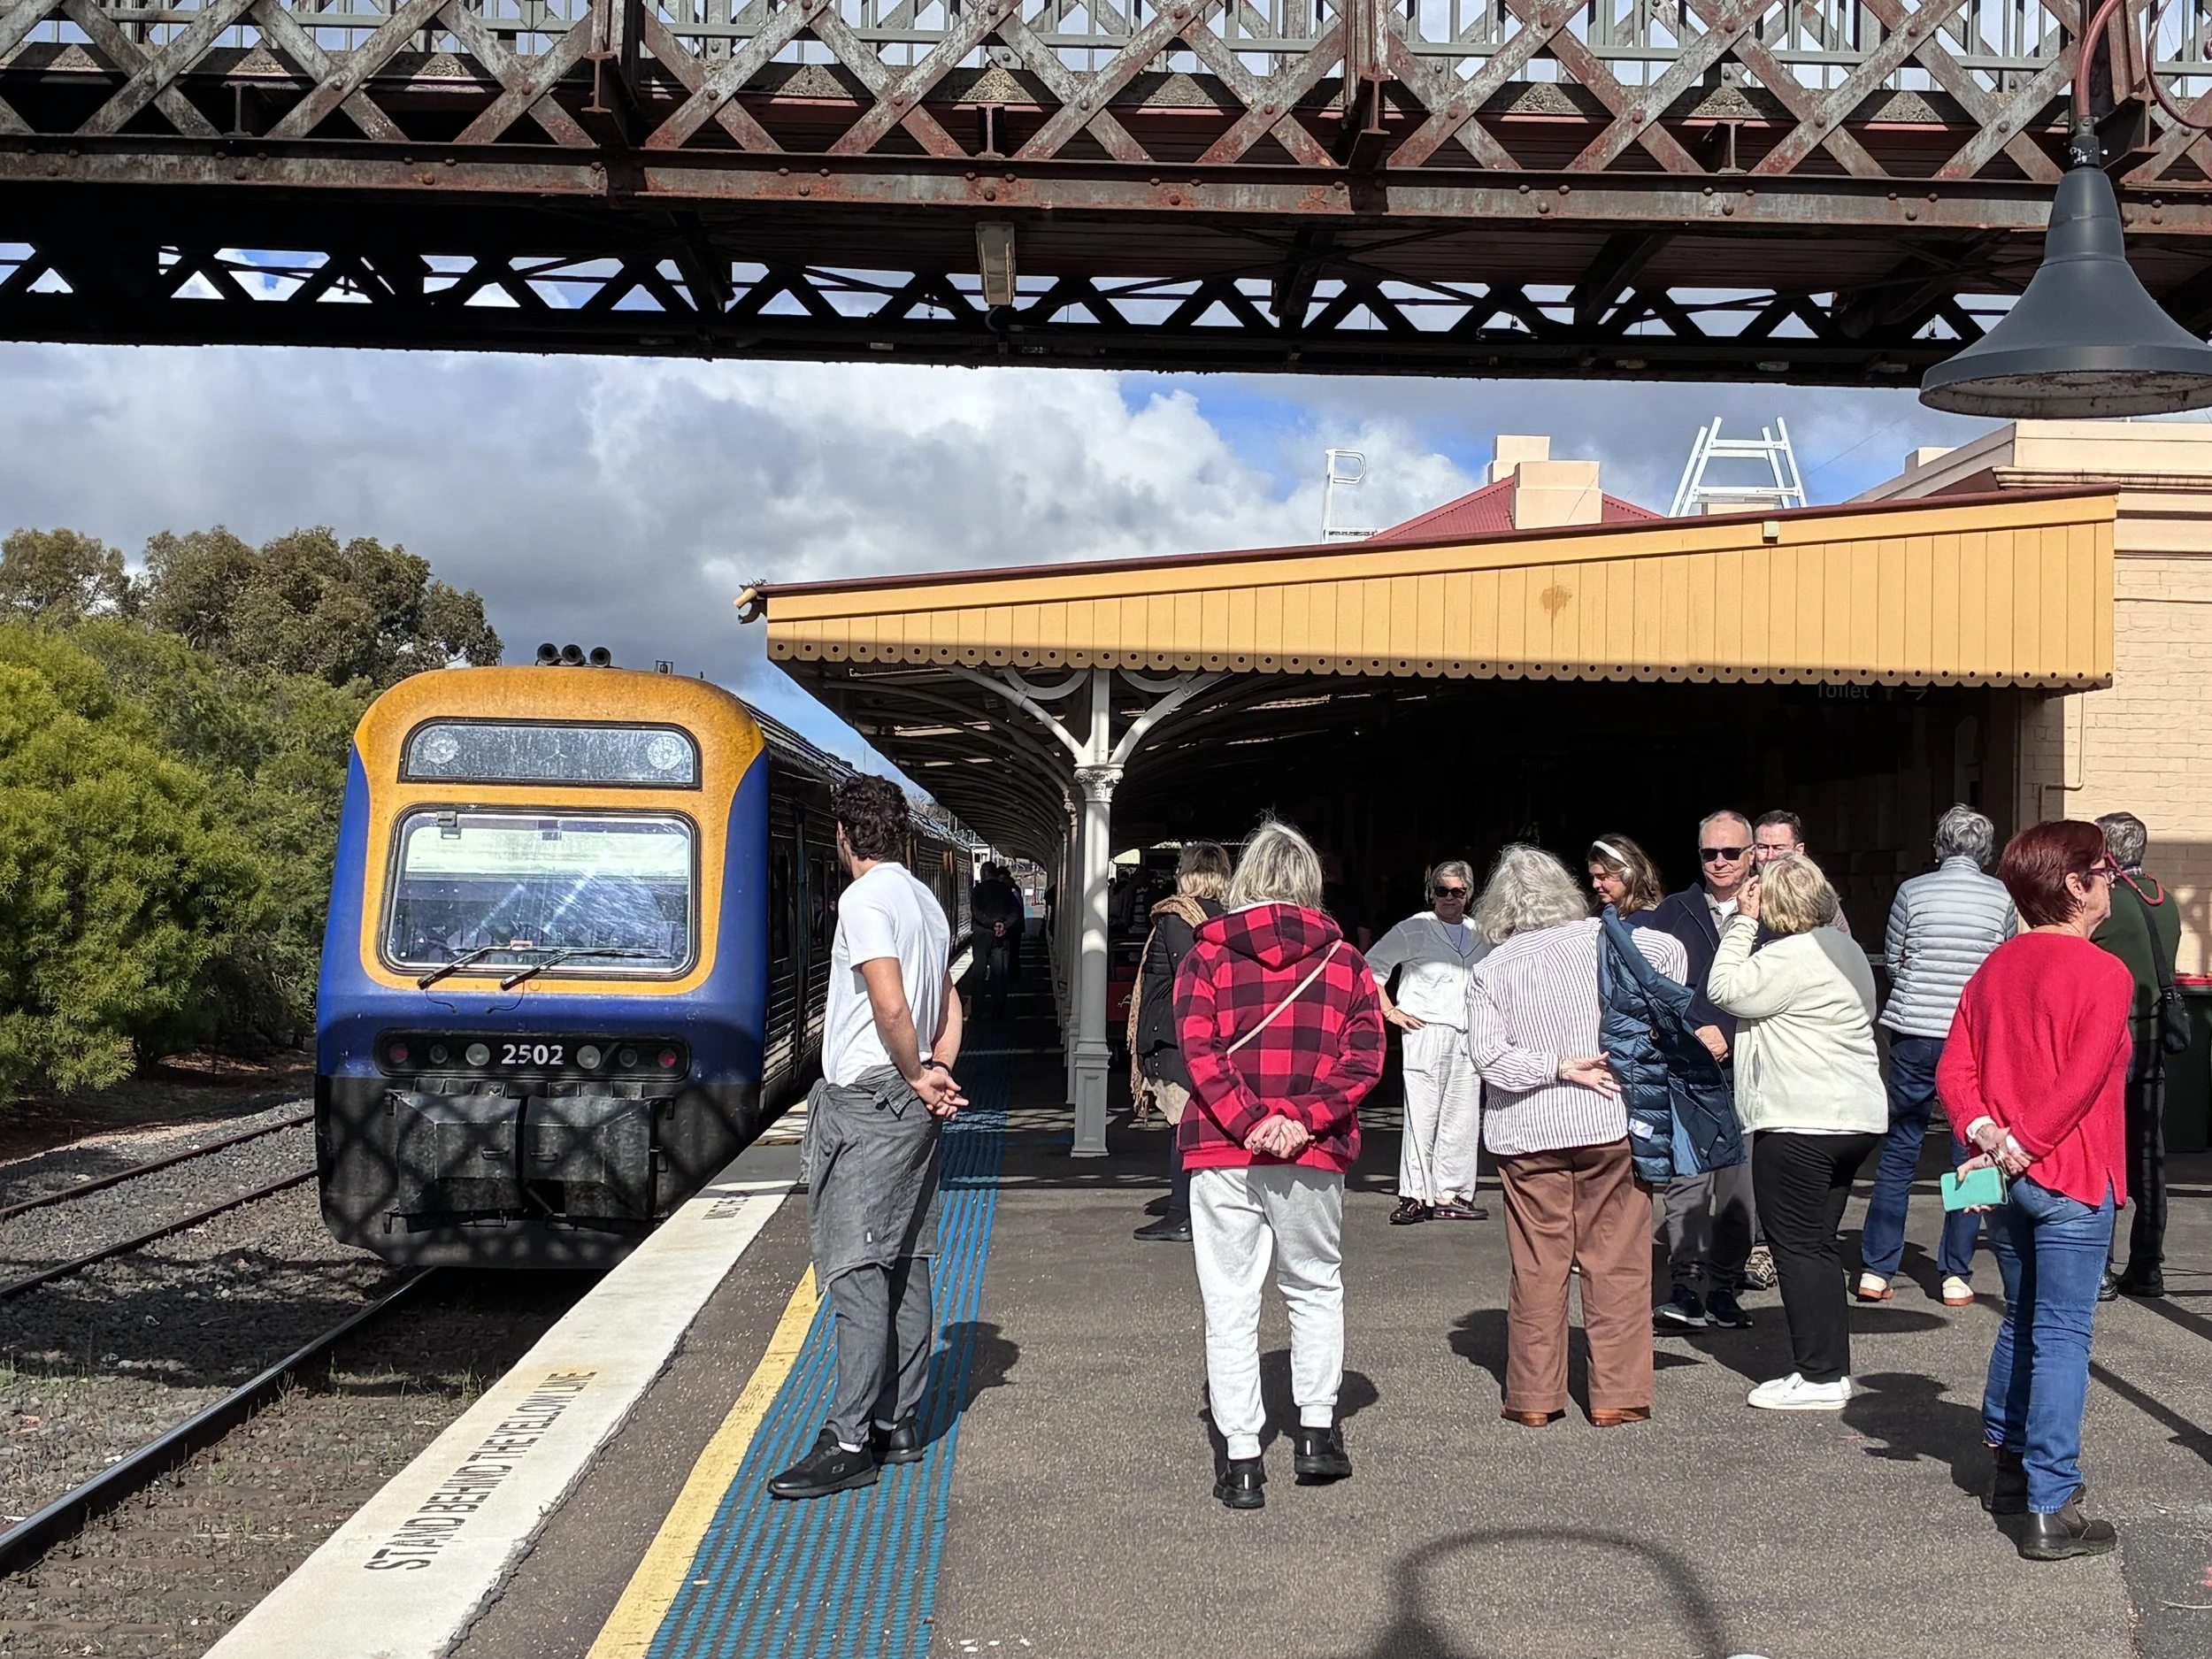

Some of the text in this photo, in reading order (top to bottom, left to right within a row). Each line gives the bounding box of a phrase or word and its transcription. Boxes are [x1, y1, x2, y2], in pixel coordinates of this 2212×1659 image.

[501, 1044, 565, 1065] 2502
[364, 1371, 598, 1571] STAND BEHIND THE YELLOW LINE
